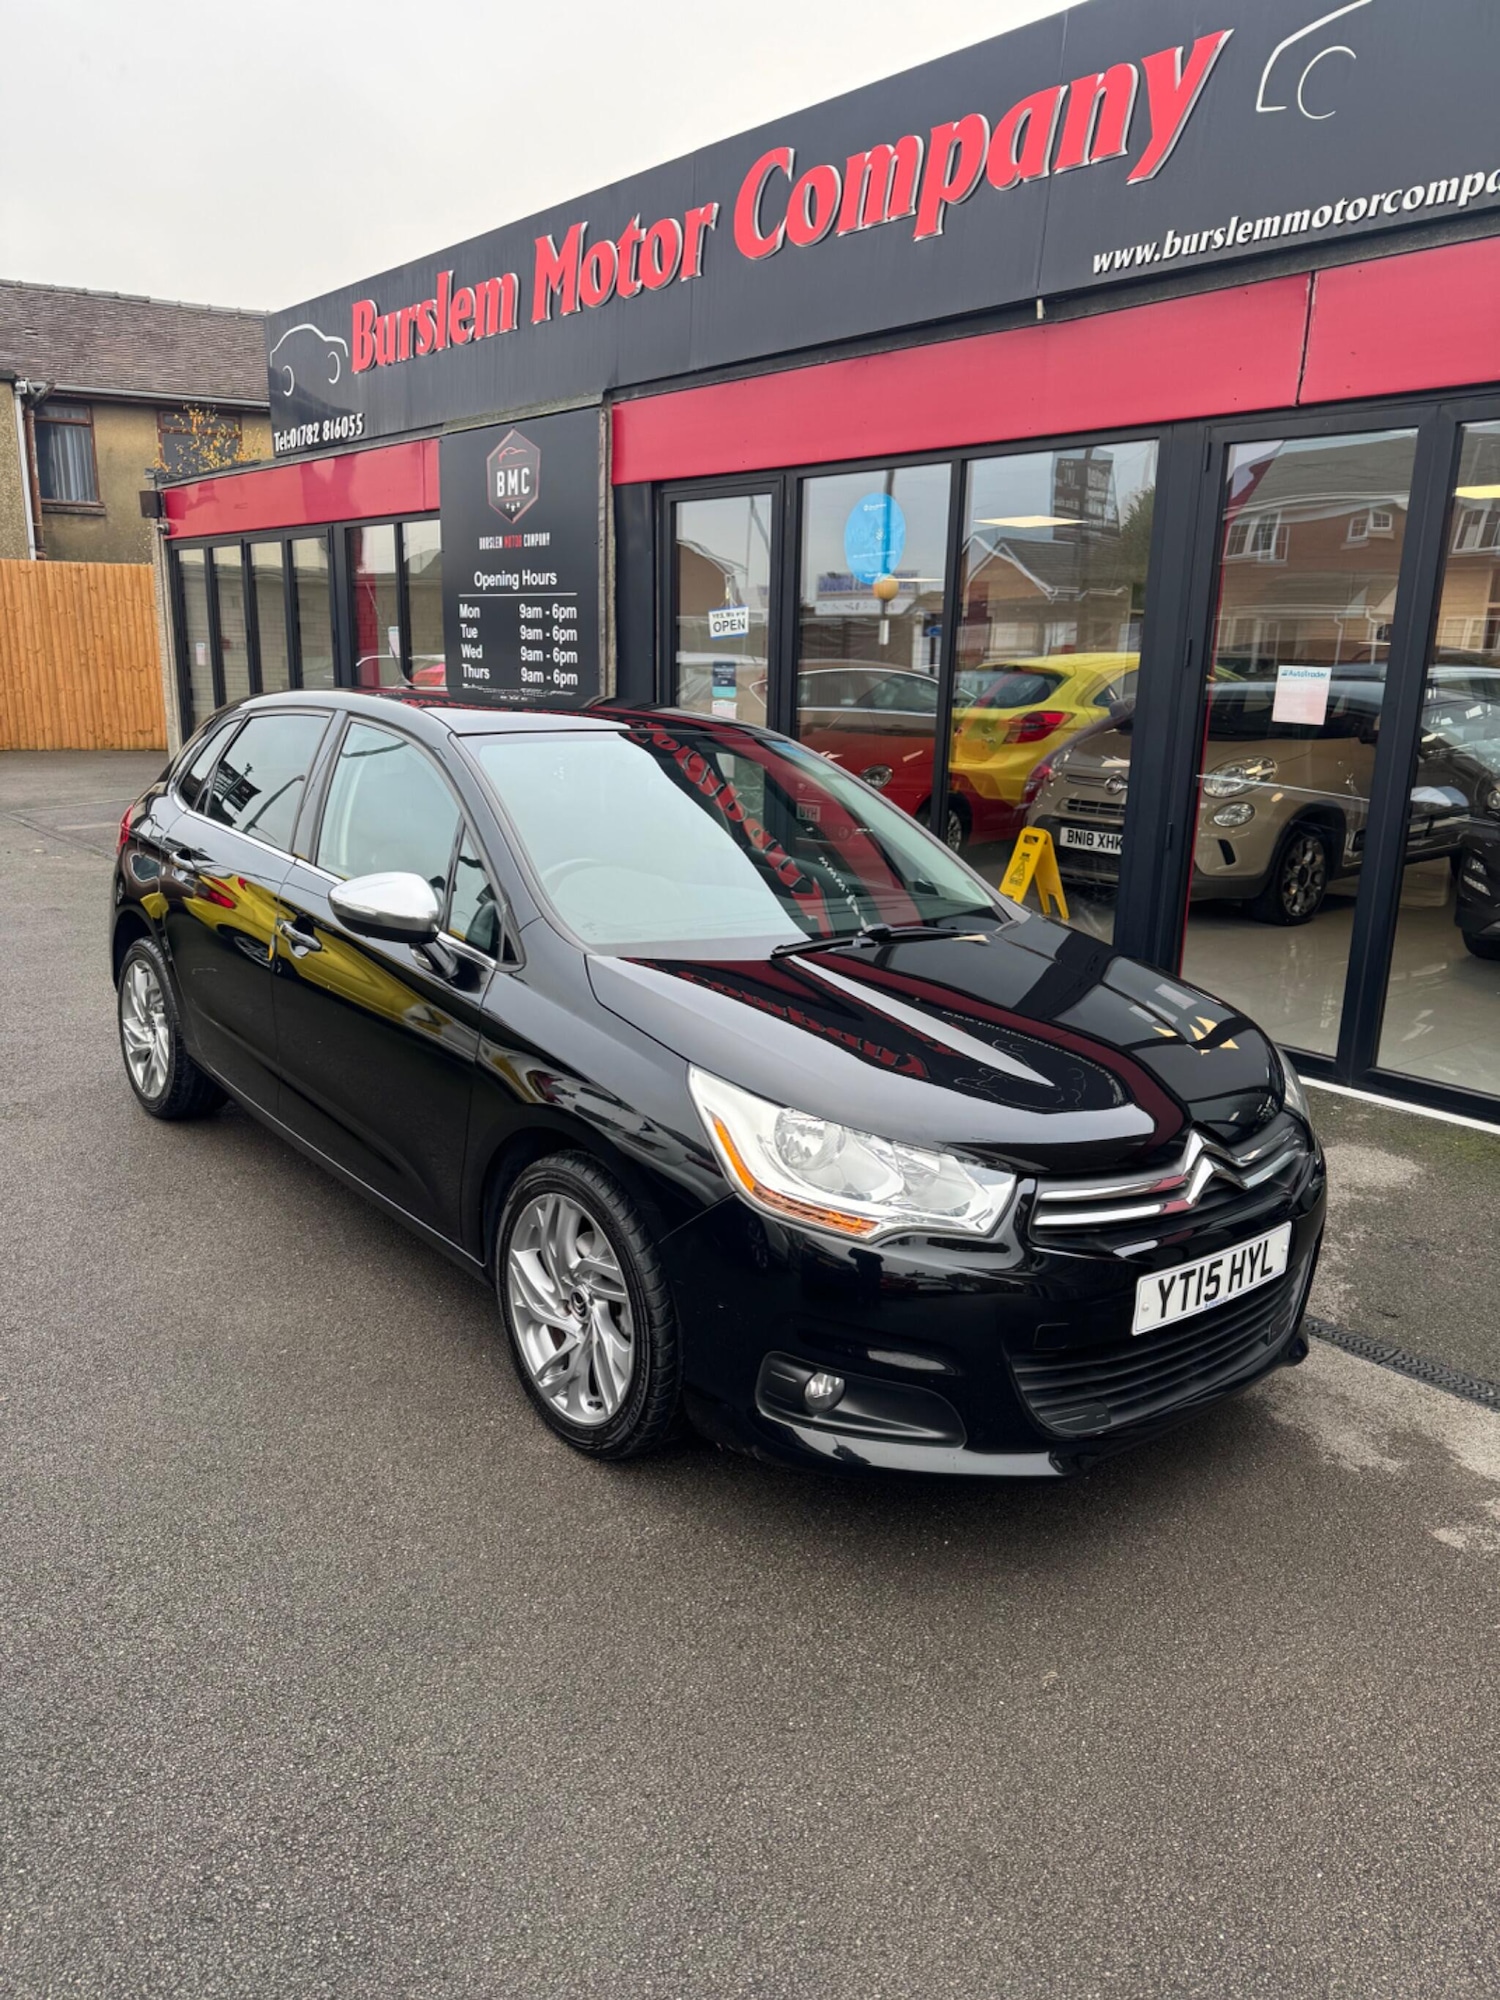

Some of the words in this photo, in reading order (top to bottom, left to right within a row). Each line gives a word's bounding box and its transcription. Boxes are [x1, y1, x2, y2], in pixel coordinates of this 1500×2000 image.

[351, 269, 520, 374] Burslem
[530, 202, 720, 325] Motor
[732, 28, 1234, 260] Company
[322, 413, 363, 441] 816055
[496, 467, 531, 497] BMC
[473, 570, 519, 591] Opening
[521, 569, 558, 586] Hours
[459, 603, 481, 619] Mon
[519, 603, 543, 619] 9am
[551, 603, 578, 623] 6pm
[460, 623, 479, 639] Tue
[519, 624, 544, 641] 9am
[552, 625, 578, 645] 6pm
[712, 618, 746, 633] OPEN
[460, 643, 483, 659] Wed
[520, 645, 544, 662] 9am
[552, 647, 578, 667] 6pm
[461, 663, 491, 680] Thurs
[520, 667, 545, 683] 9am
[552, 668, 579, 689] 6pm
[1066, 829, 1095, 846] BN18
[1157, 1258, 1224, 1319] YT15
[1228, 1240, 1273, 1294] HYL
